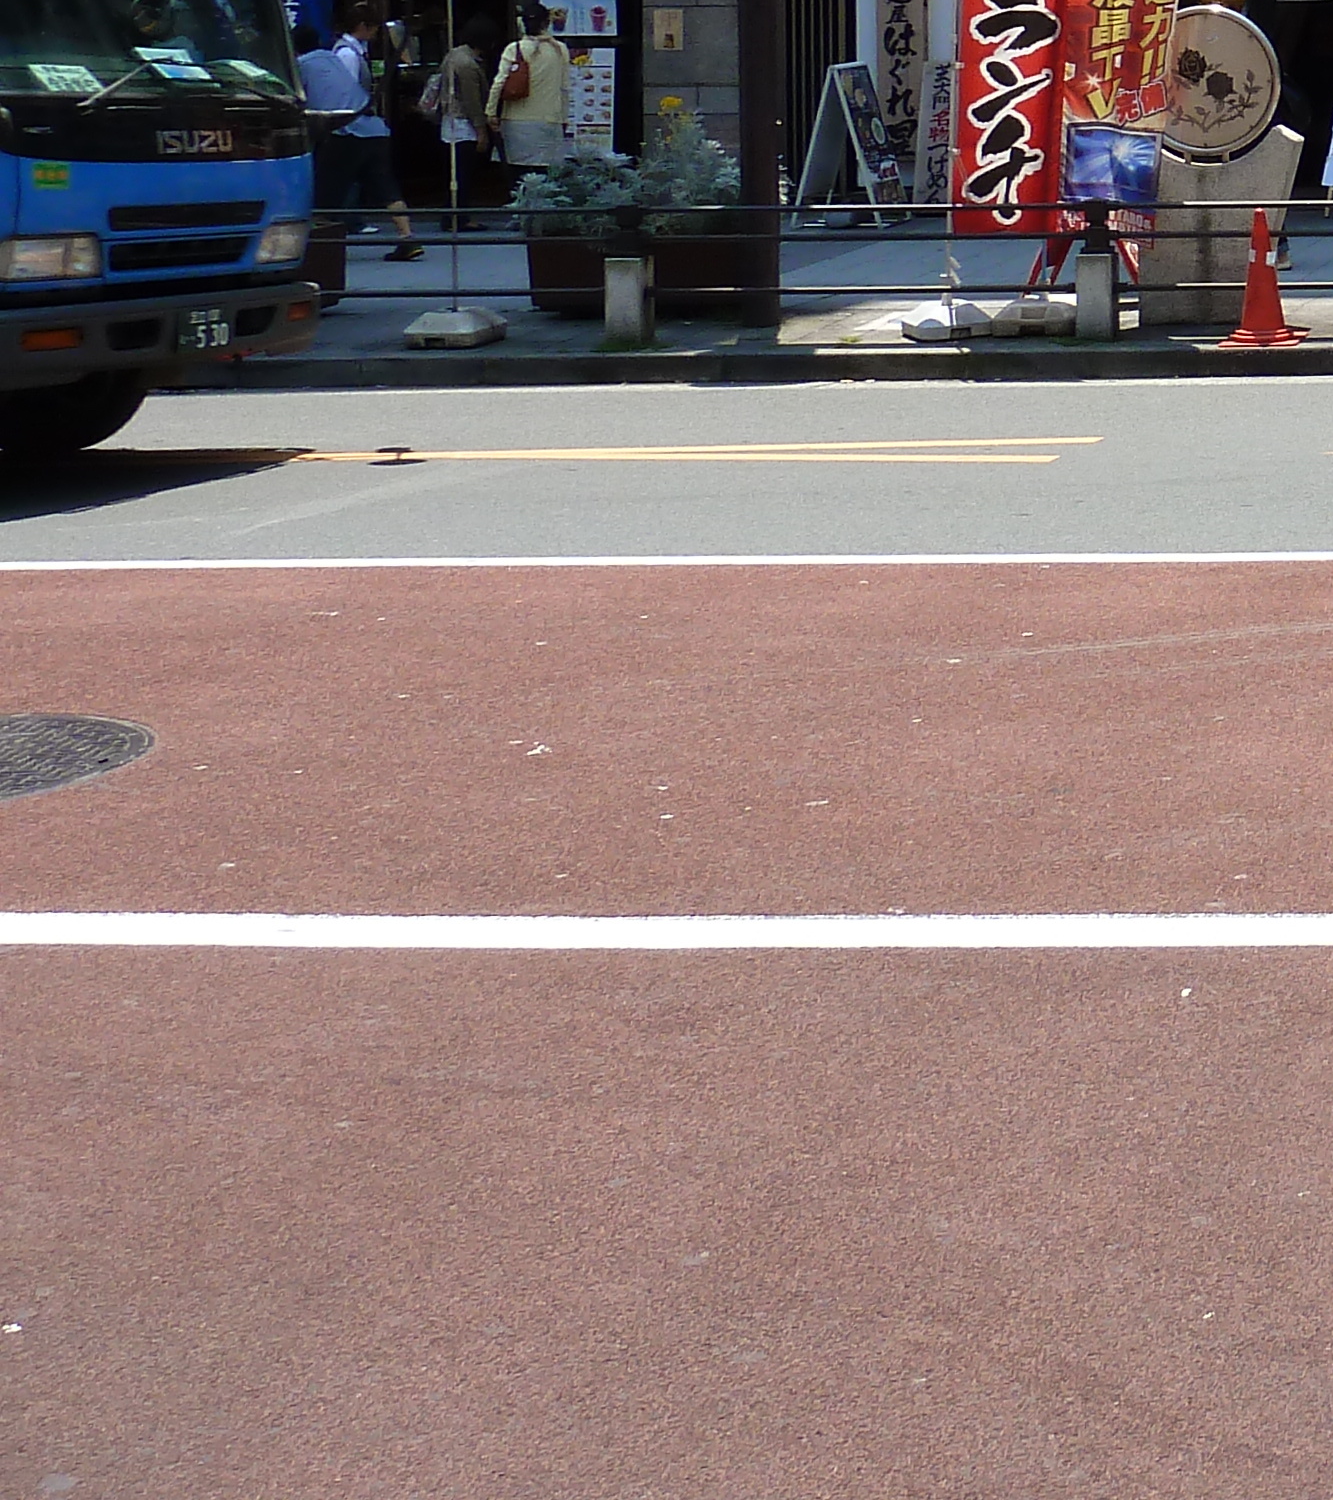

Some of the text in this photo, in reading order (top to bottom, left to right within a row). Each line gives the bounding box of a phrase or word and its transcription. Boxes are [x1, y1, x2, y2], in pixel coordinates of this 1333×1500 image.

[883, 24, 918, 157] はぐれ星
[155, 128, 235, 154] ISUZU
